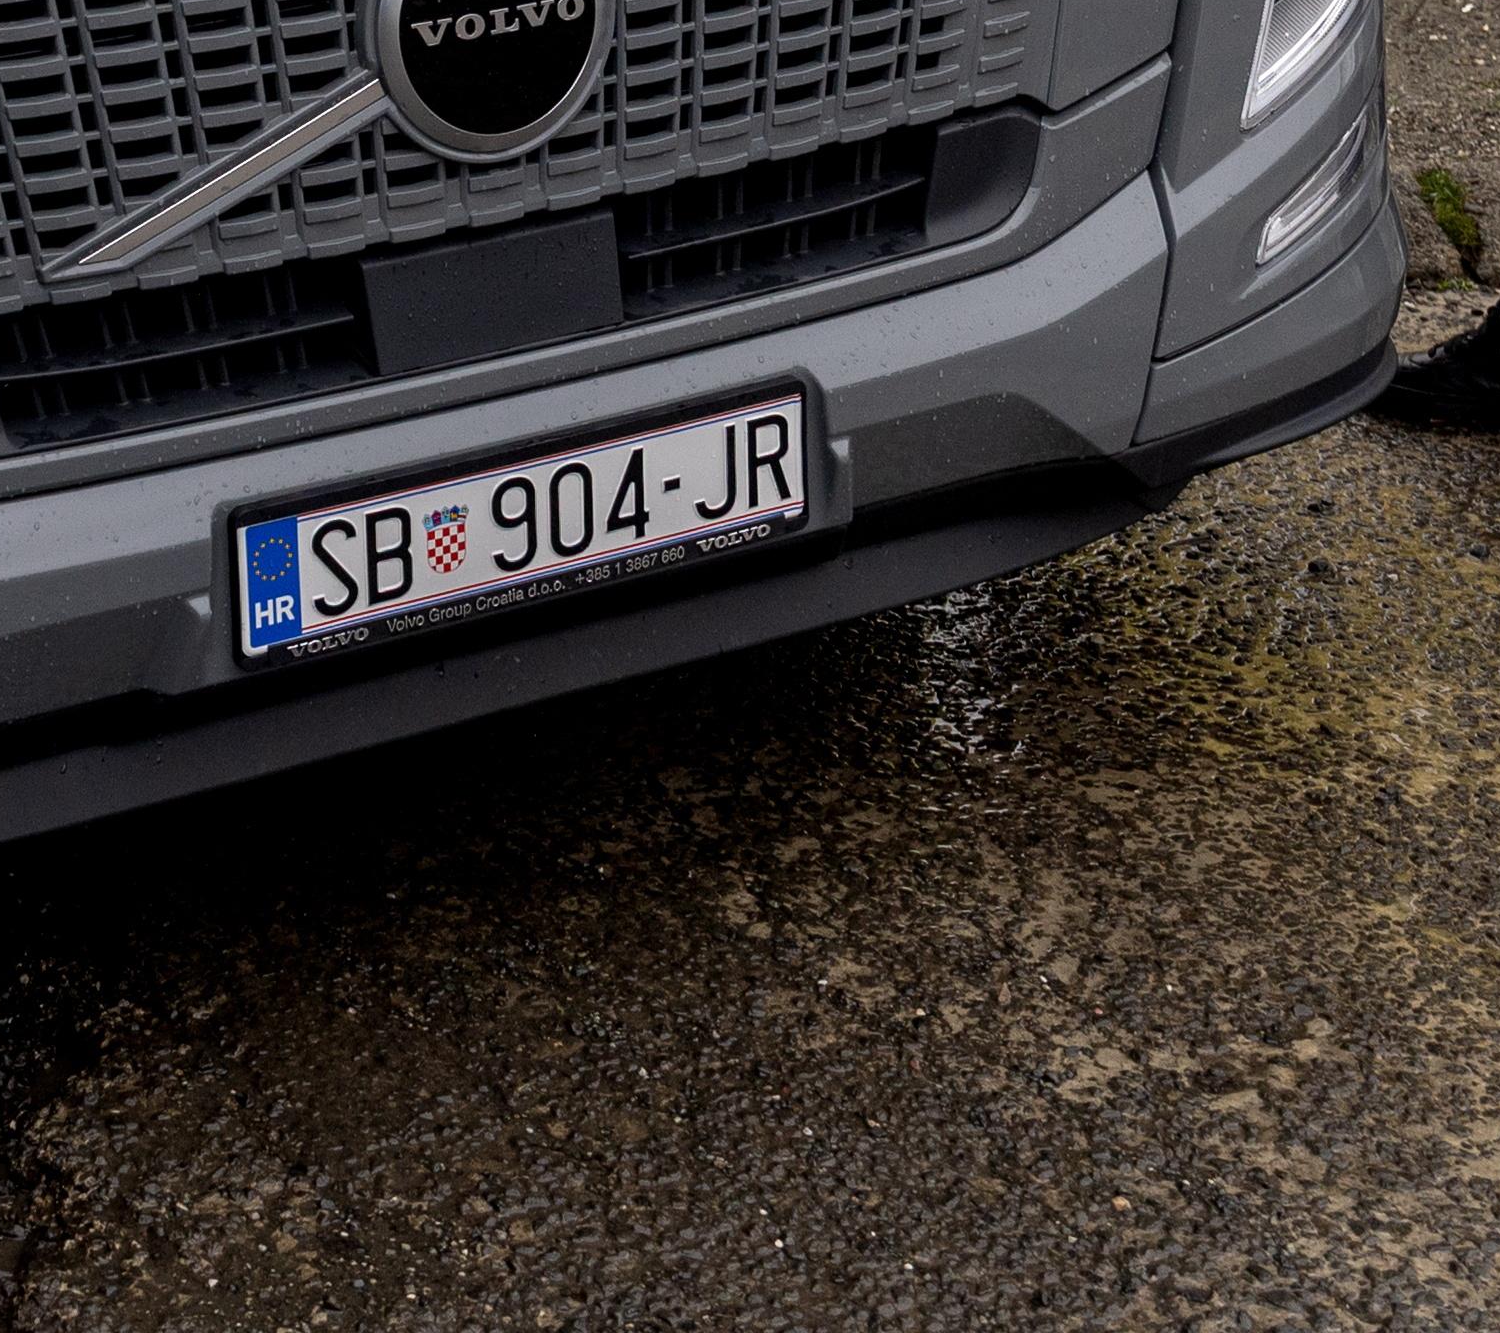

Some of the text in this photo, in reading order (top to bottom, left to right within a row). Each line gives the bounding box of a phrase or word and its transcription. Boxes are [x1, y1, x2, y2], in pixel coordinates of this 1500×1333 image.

[311, 414, 792, 616] SB 904-JR
[696, 523, 772, 553] VOLVO
[387, 546, 686, 633] Volvo Group Croatia d.o.o. +385 1 3867 660
[255, 595, 295, 629] HR
[286, 627, 369, 658] VOLVO
